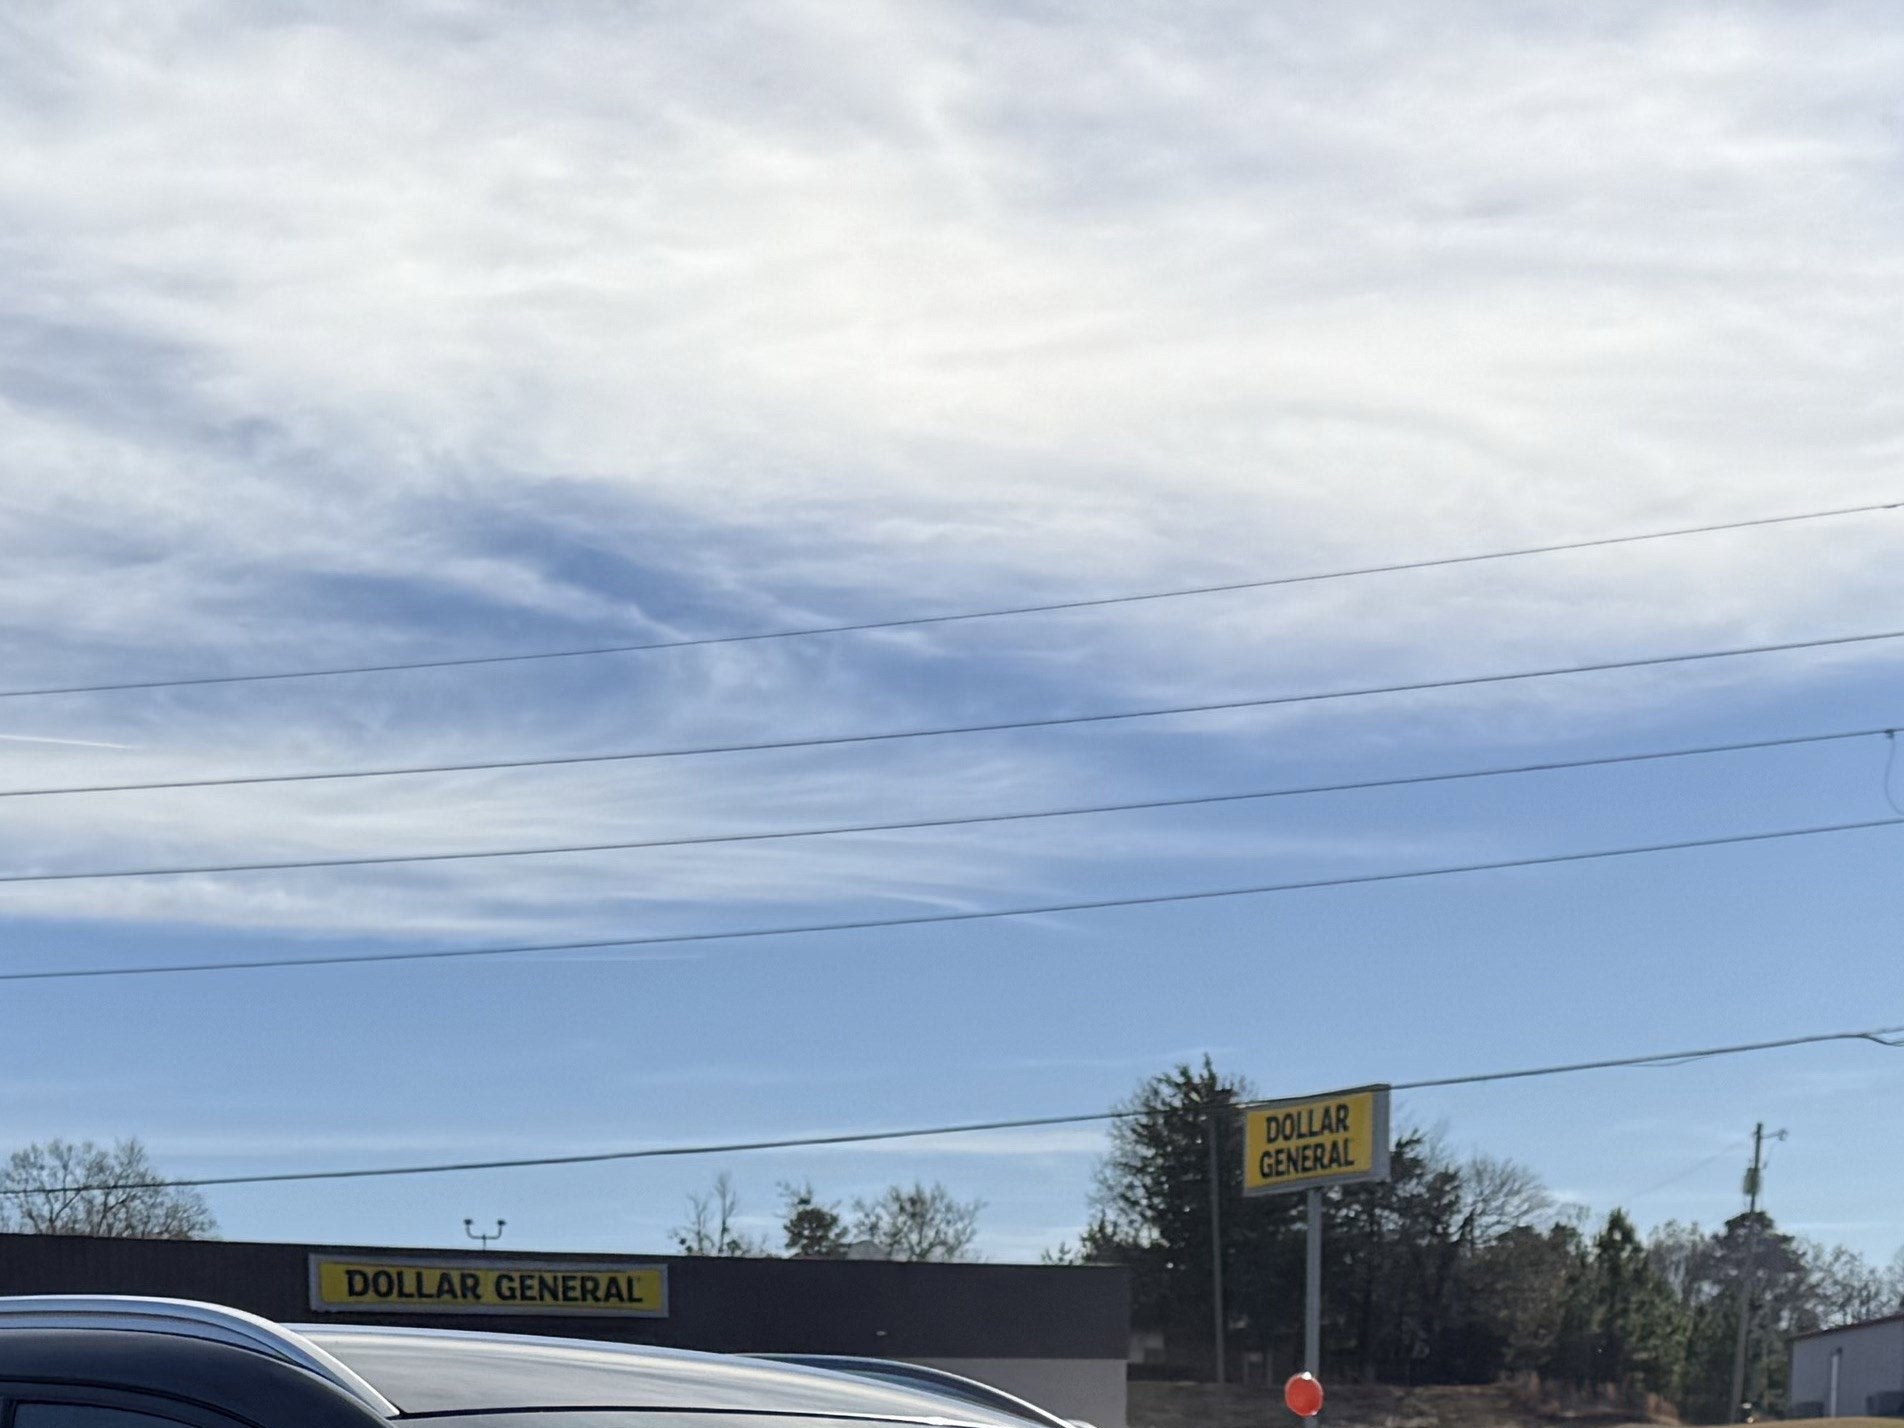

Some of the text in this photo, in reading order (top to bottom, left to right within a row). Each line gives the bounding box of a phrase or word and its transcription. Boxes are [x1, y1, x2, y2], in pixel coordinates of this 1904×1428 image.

[1266, 1104, 1349, 1143] DOLLAR
[1260, 1138, 1354, 1178] GENERAL
[345, 1270, 643, 1303] DOLLAR GENERAL
